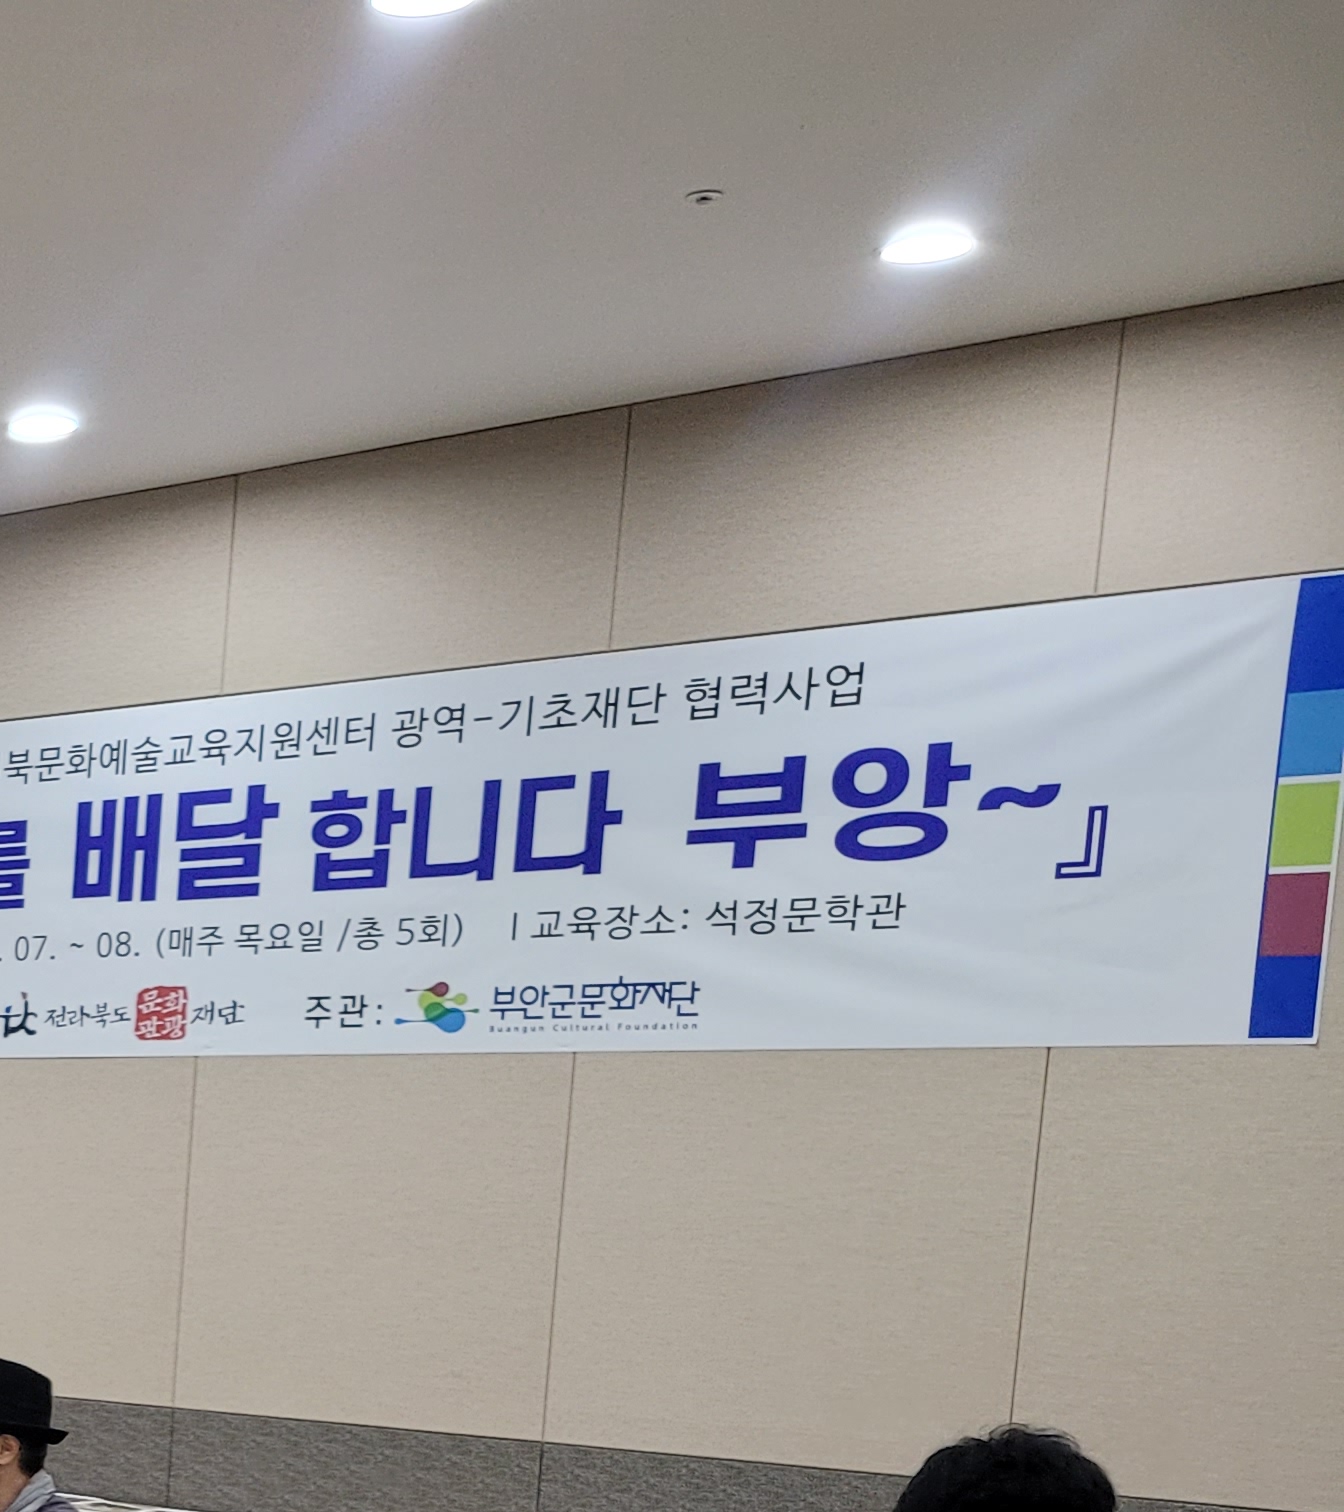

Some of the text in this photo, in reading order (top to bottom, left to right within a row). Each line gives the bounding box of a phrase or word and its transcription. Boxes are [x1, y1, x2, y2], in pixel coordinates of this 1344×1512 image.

[391, 682, 668, 749] 광역-기초재단
[683, 661, 865, 721] 협력사업
[71, 783, 281, 903] 배달
[309, 769, 624, 893] 합니다
[96, 930, 140, 959] 08.
[156, 926, 225, 959] (매주
[233, 919, 324, 955] 목요일
[336, 916, 385, 953] /총
[395, 913, 463, 948] 5회)
[529, 891, 907, 942] 교육장소: 석정문학관
[44, 1002, 132, 1029] 전라북도
[190, 999, 246, 1026] 재단
[304, 994, 383, 1030] 주관:
[489, 975, 702, 1021] 부안군문화재단
[488, 1021, 699, 1034] Buangun Cultural Foundation
